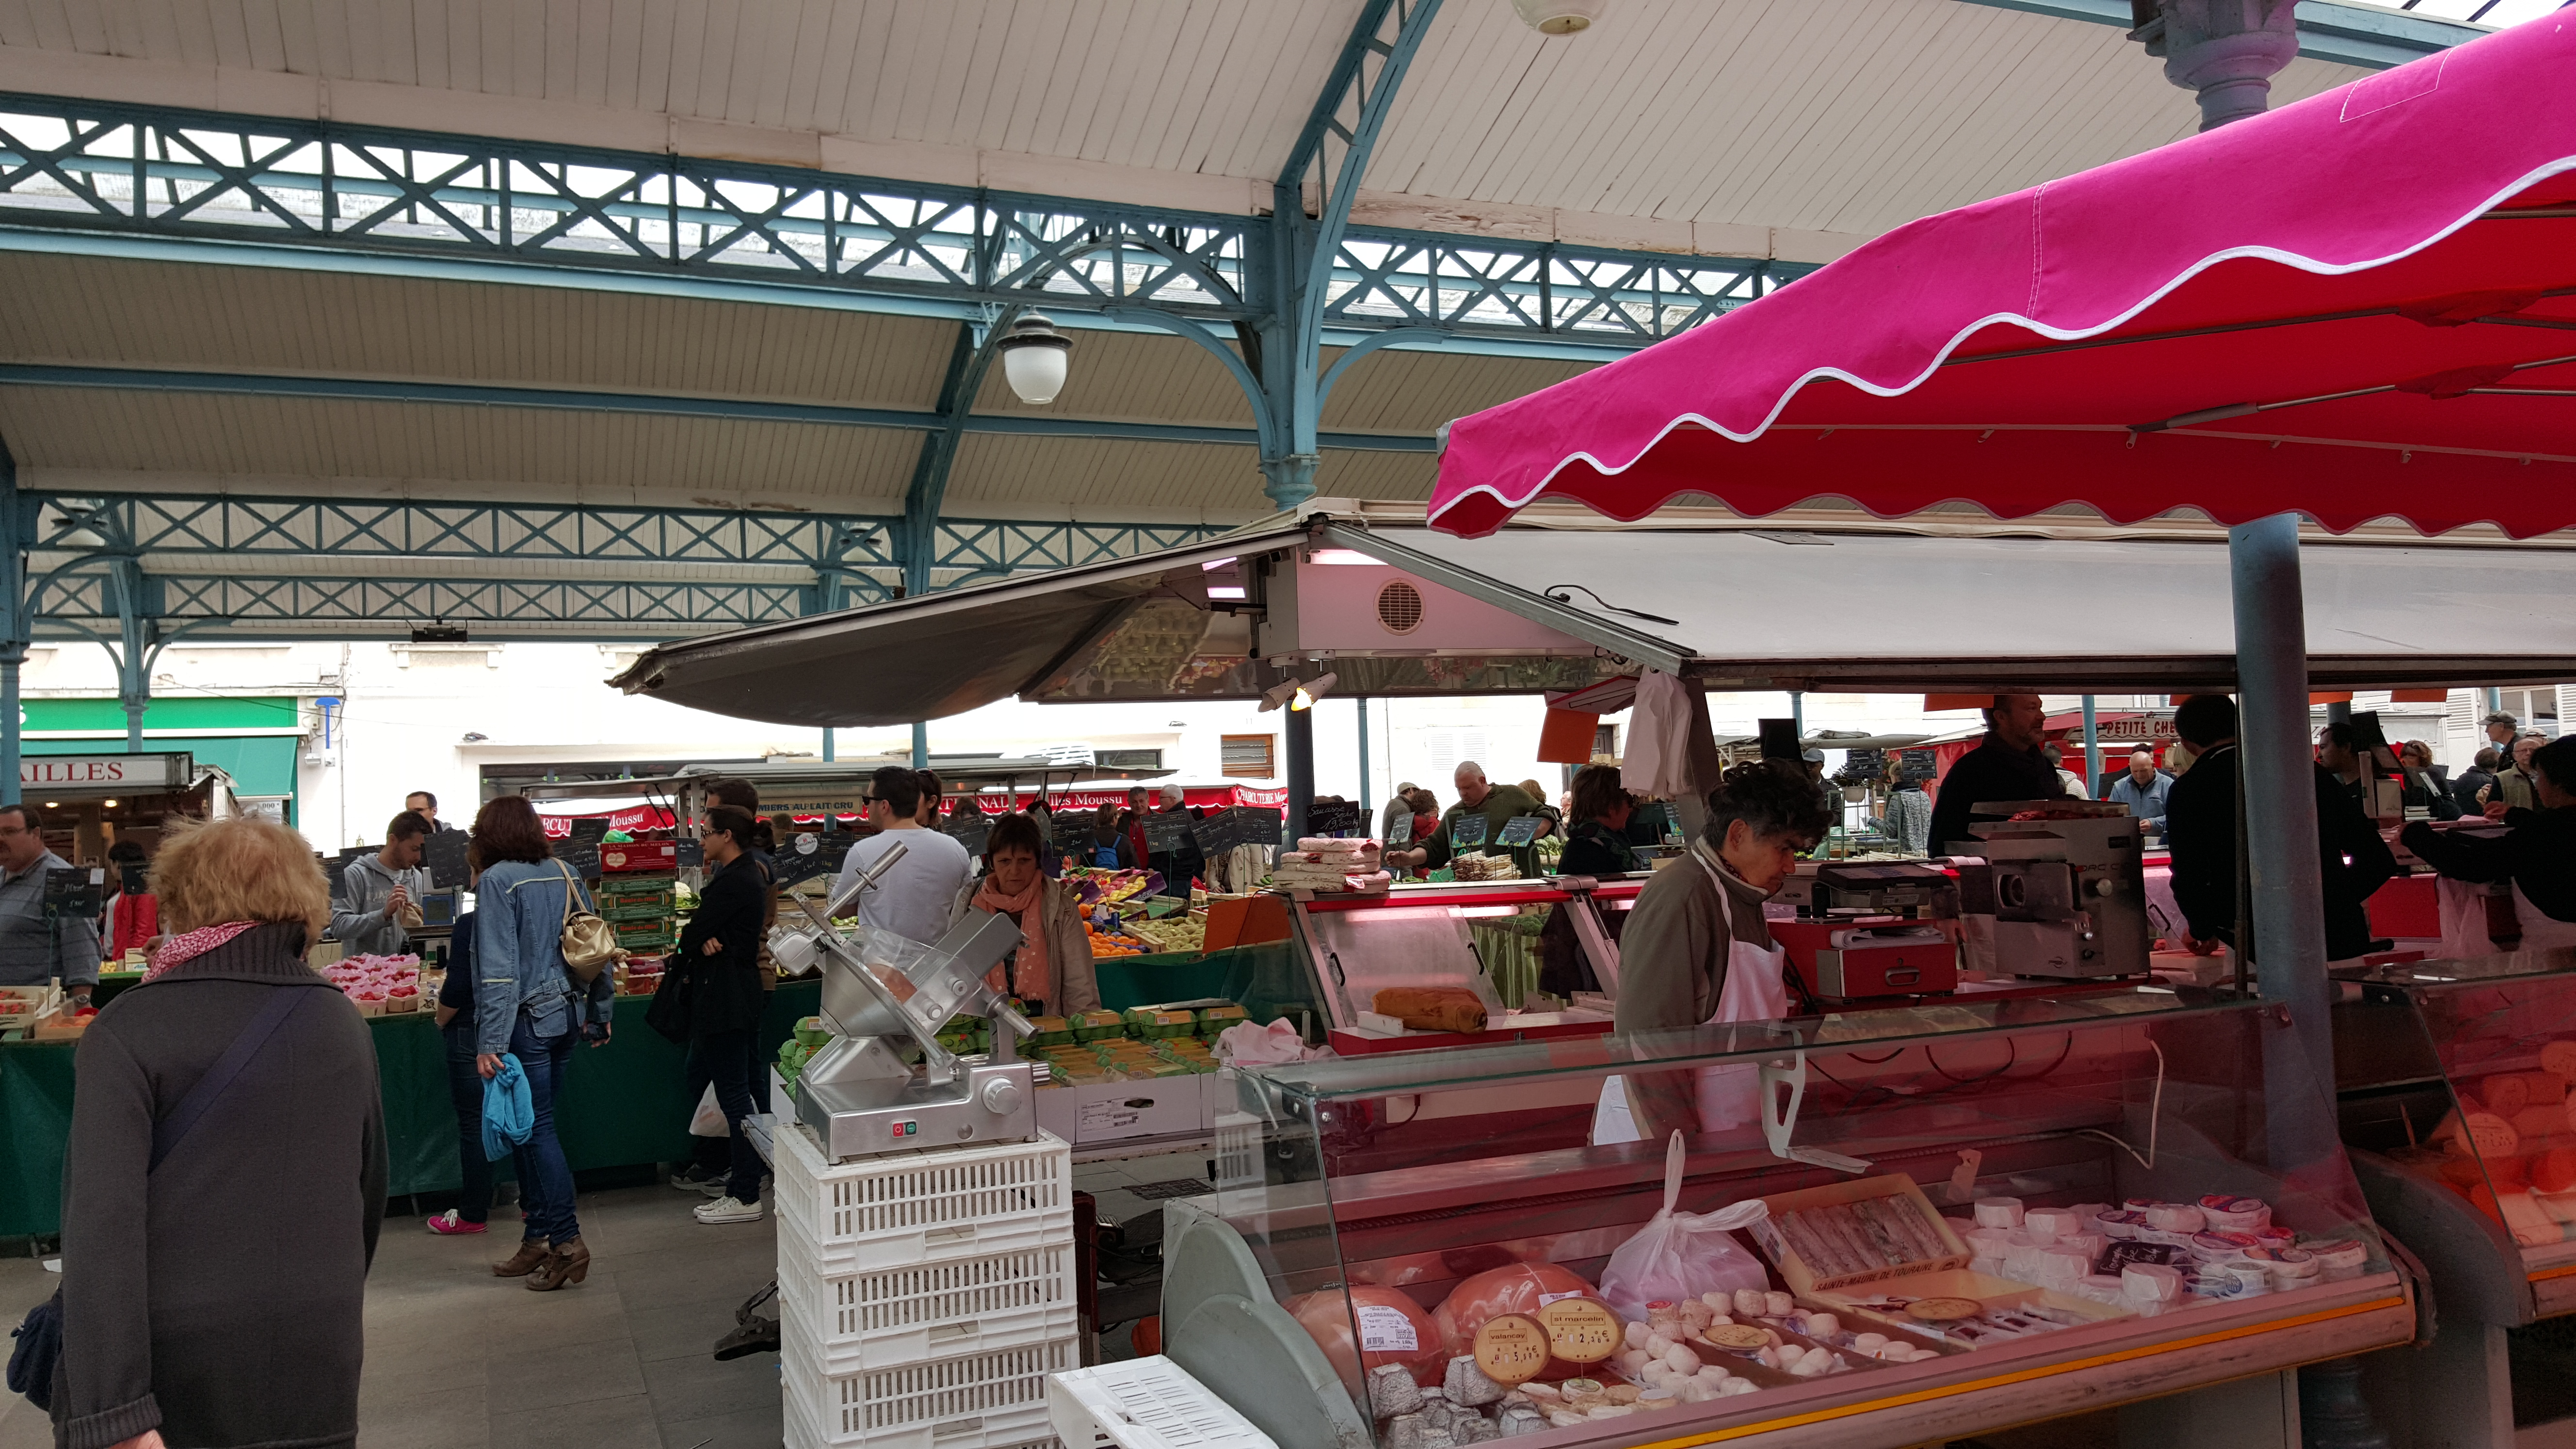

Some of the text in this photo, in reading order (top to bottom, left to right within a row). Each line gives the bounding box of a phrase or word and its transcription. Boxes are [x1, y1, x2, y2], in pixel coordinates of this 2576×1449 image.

[2107, 721, 2146, 734] PETITE
[1075, 793, 1122, 805] Moussu
[1237, 789, 1274, 804] CHARCUTERIE
[1816, 1272, 1876, 1292] SAINTE-MAURE
[1879, 1271, 1890, 1280] DE
[1893, 1262, 1934, 1277] TOURAINE
